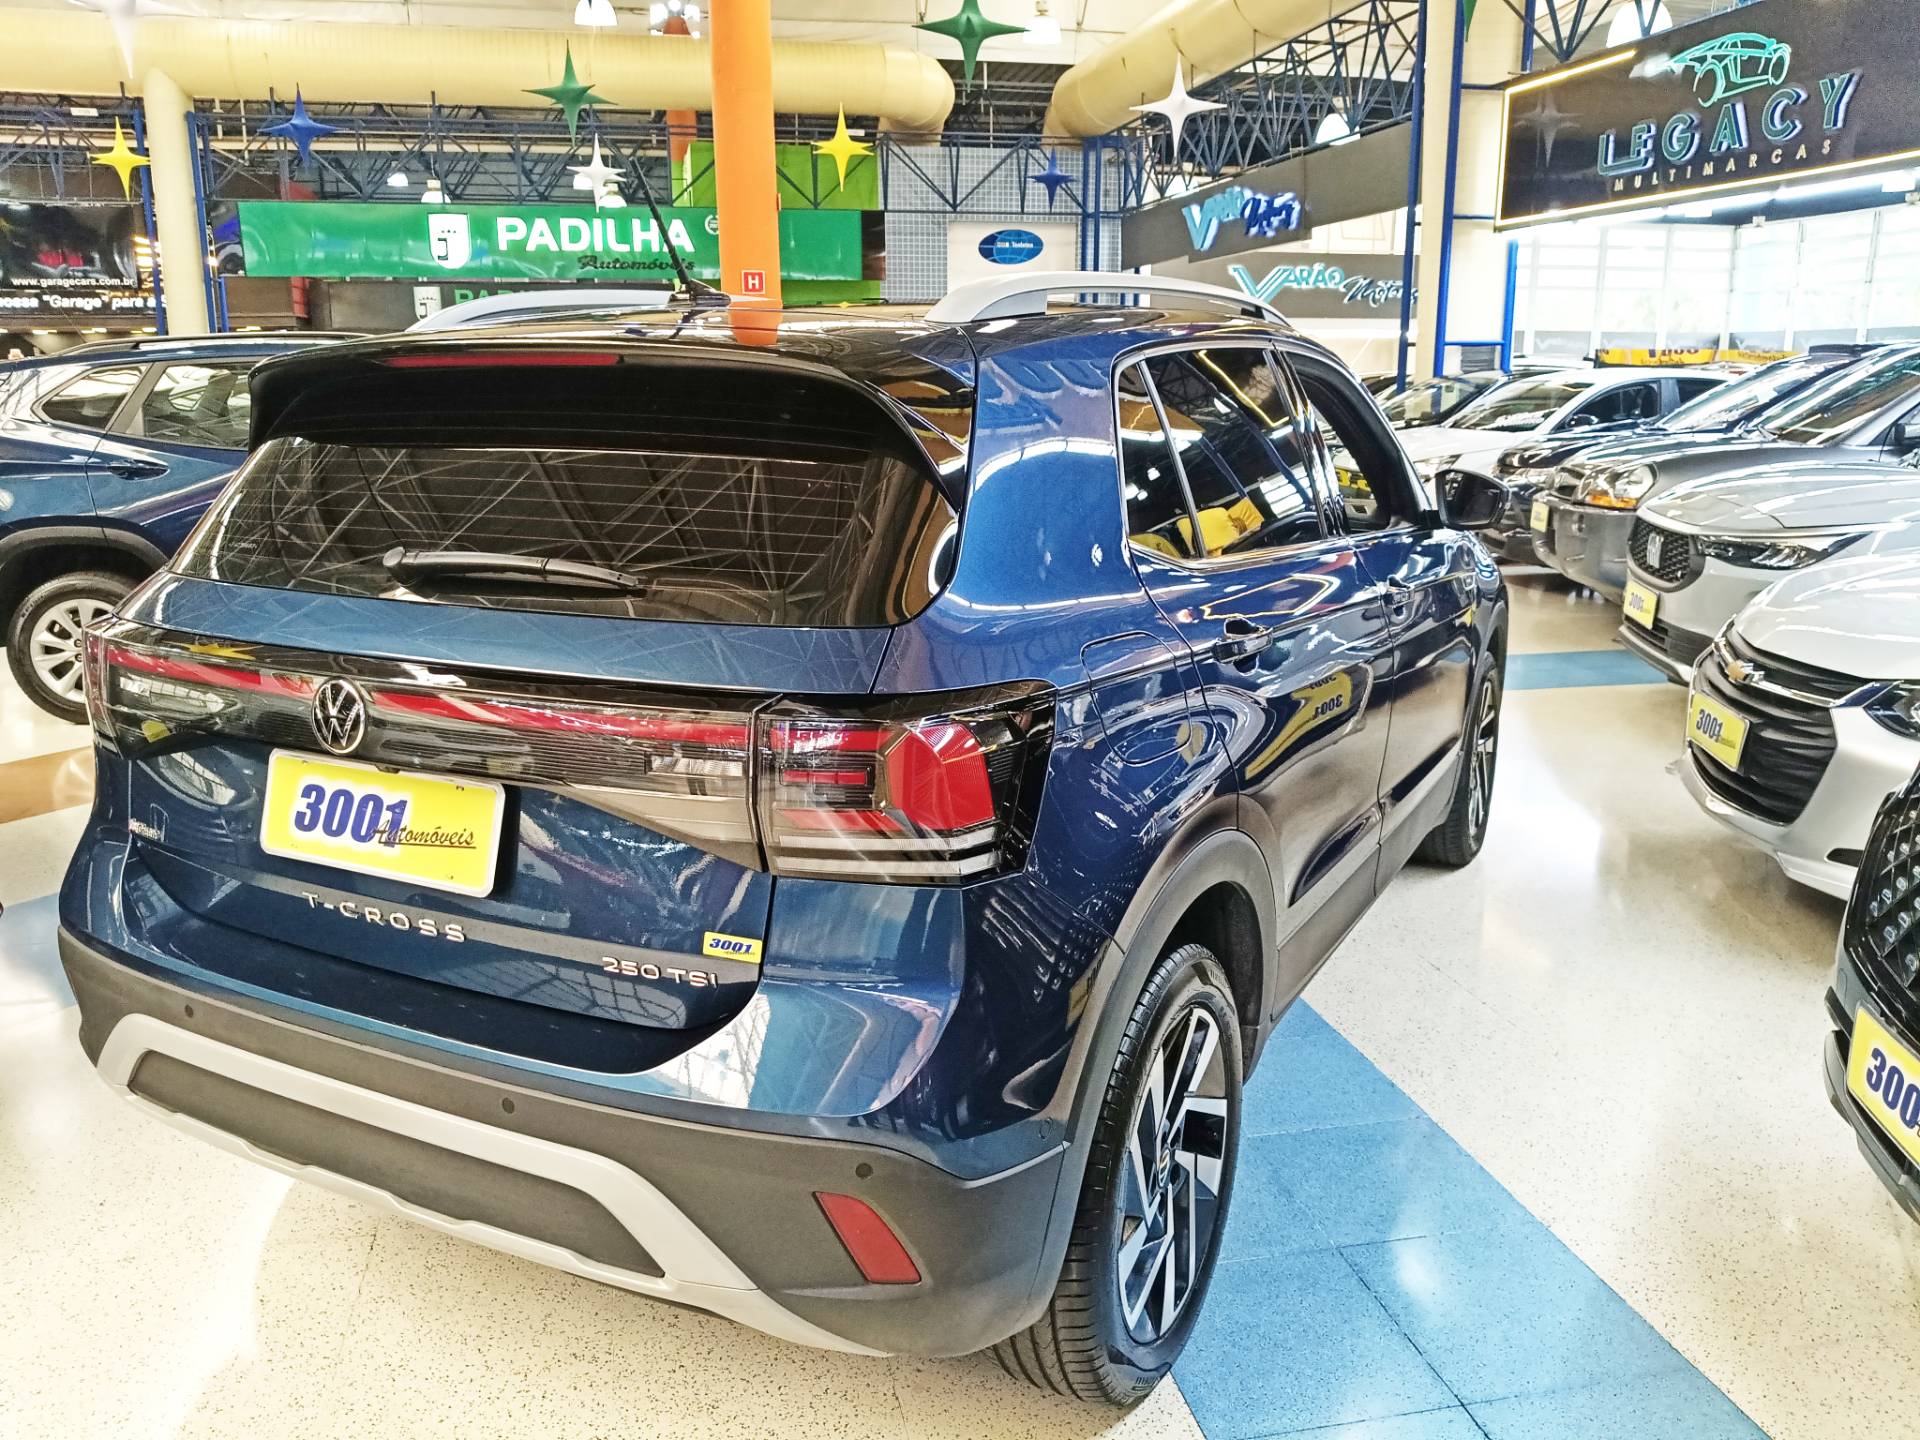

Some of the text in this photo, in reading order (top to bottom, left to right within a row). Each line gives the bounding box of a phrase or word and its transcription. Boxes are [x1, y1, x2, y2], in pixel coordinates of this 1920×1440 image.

[1598, 68, 1859, 176] LEGACY
[1614, 138, 1832, 191] MULTIMARCAS
[496, 216, 695, 253] PADILHA
[578, 255, 696, 271] Automóvs
[10, 277, 134, 288] www.garagecars.com.br
[747, 273, 760, 290] H
[1696, 708, 1723, 743] 3001
[294, 783, 408, 848] 3001
[371, 818, 477, 850] Automóveis
[302, 891, 466, 943] T-CROSS
[709, 938, 752, 953] 3001
[602, 956, 719, 989] 250 TSI
[1866, 1047, 1920, 1130] 300
